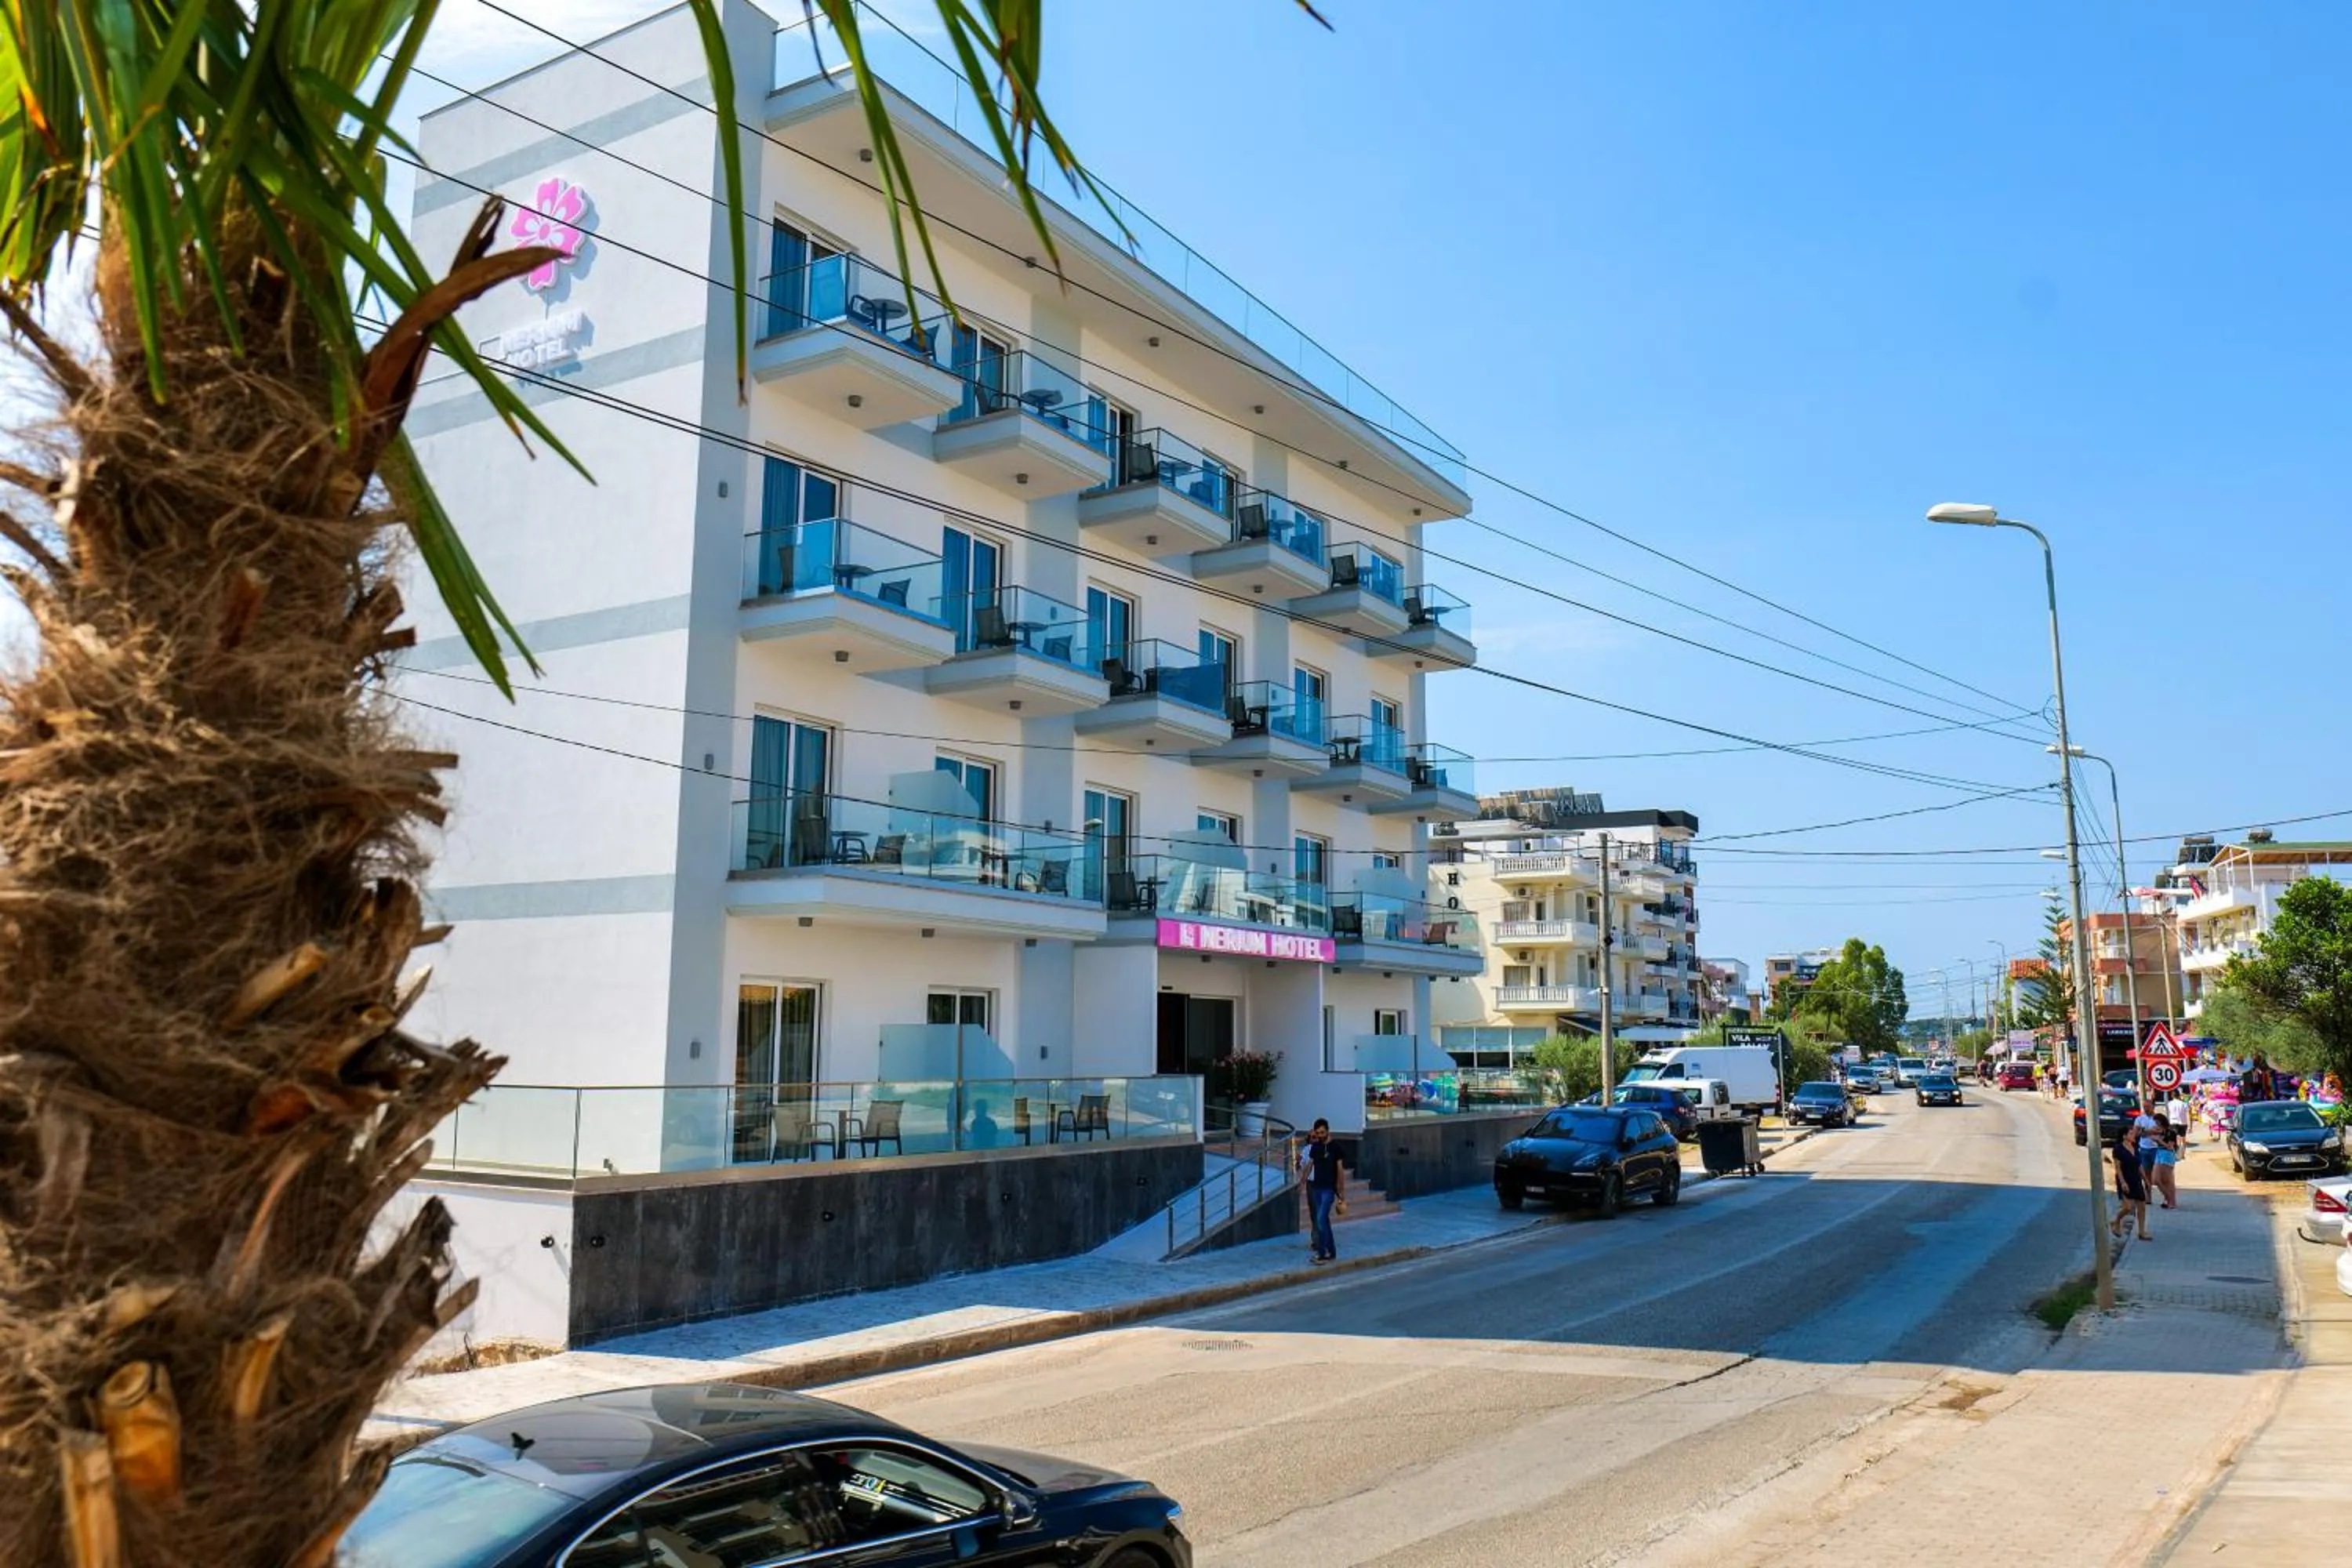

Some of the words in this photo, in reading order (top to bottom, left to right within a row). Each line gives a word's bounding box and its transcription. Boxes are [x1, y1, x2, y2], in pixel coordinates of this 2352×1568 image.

[1200, 925, 1265, 954] NERIUM
[1271, 934, 1324, 960] HOTEL
[2155, 1068, 2174, 1081] 30
